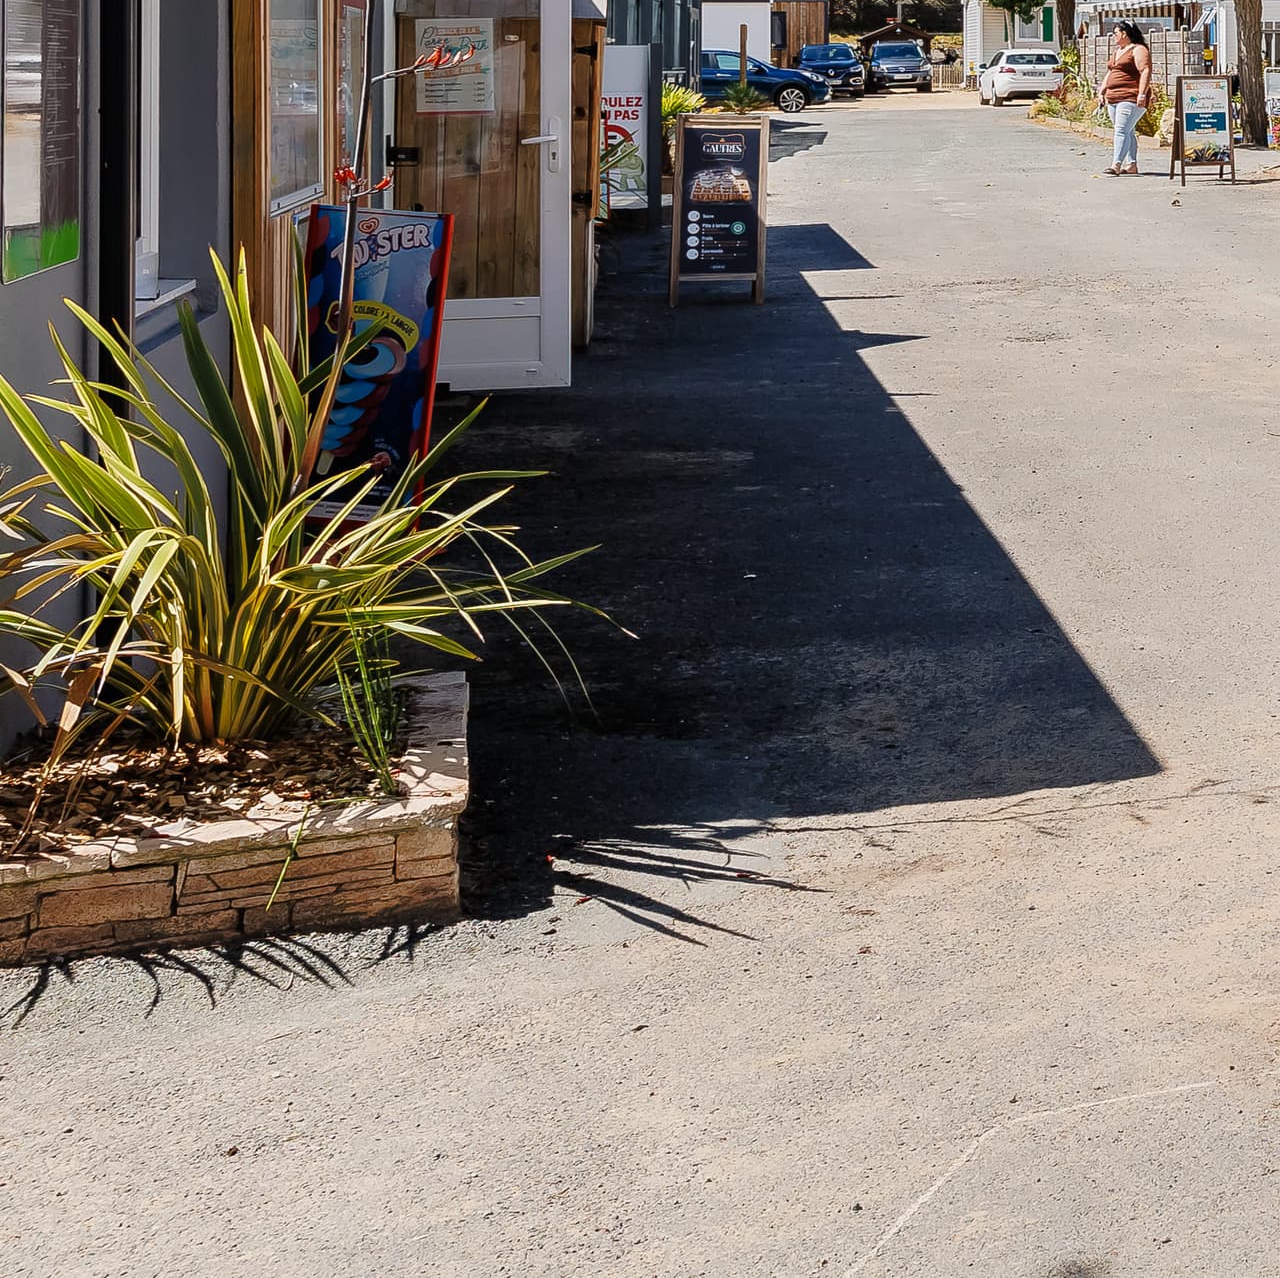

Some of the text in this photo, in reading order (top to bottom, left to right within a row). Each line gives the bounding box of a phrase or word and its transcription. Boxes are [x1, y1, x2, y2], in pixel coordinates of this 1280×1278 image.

[600, 97, 643, 108] OULEZ
[614, 110, 640, 120] PAS
[391, 315, 415, 337] LANGUE
